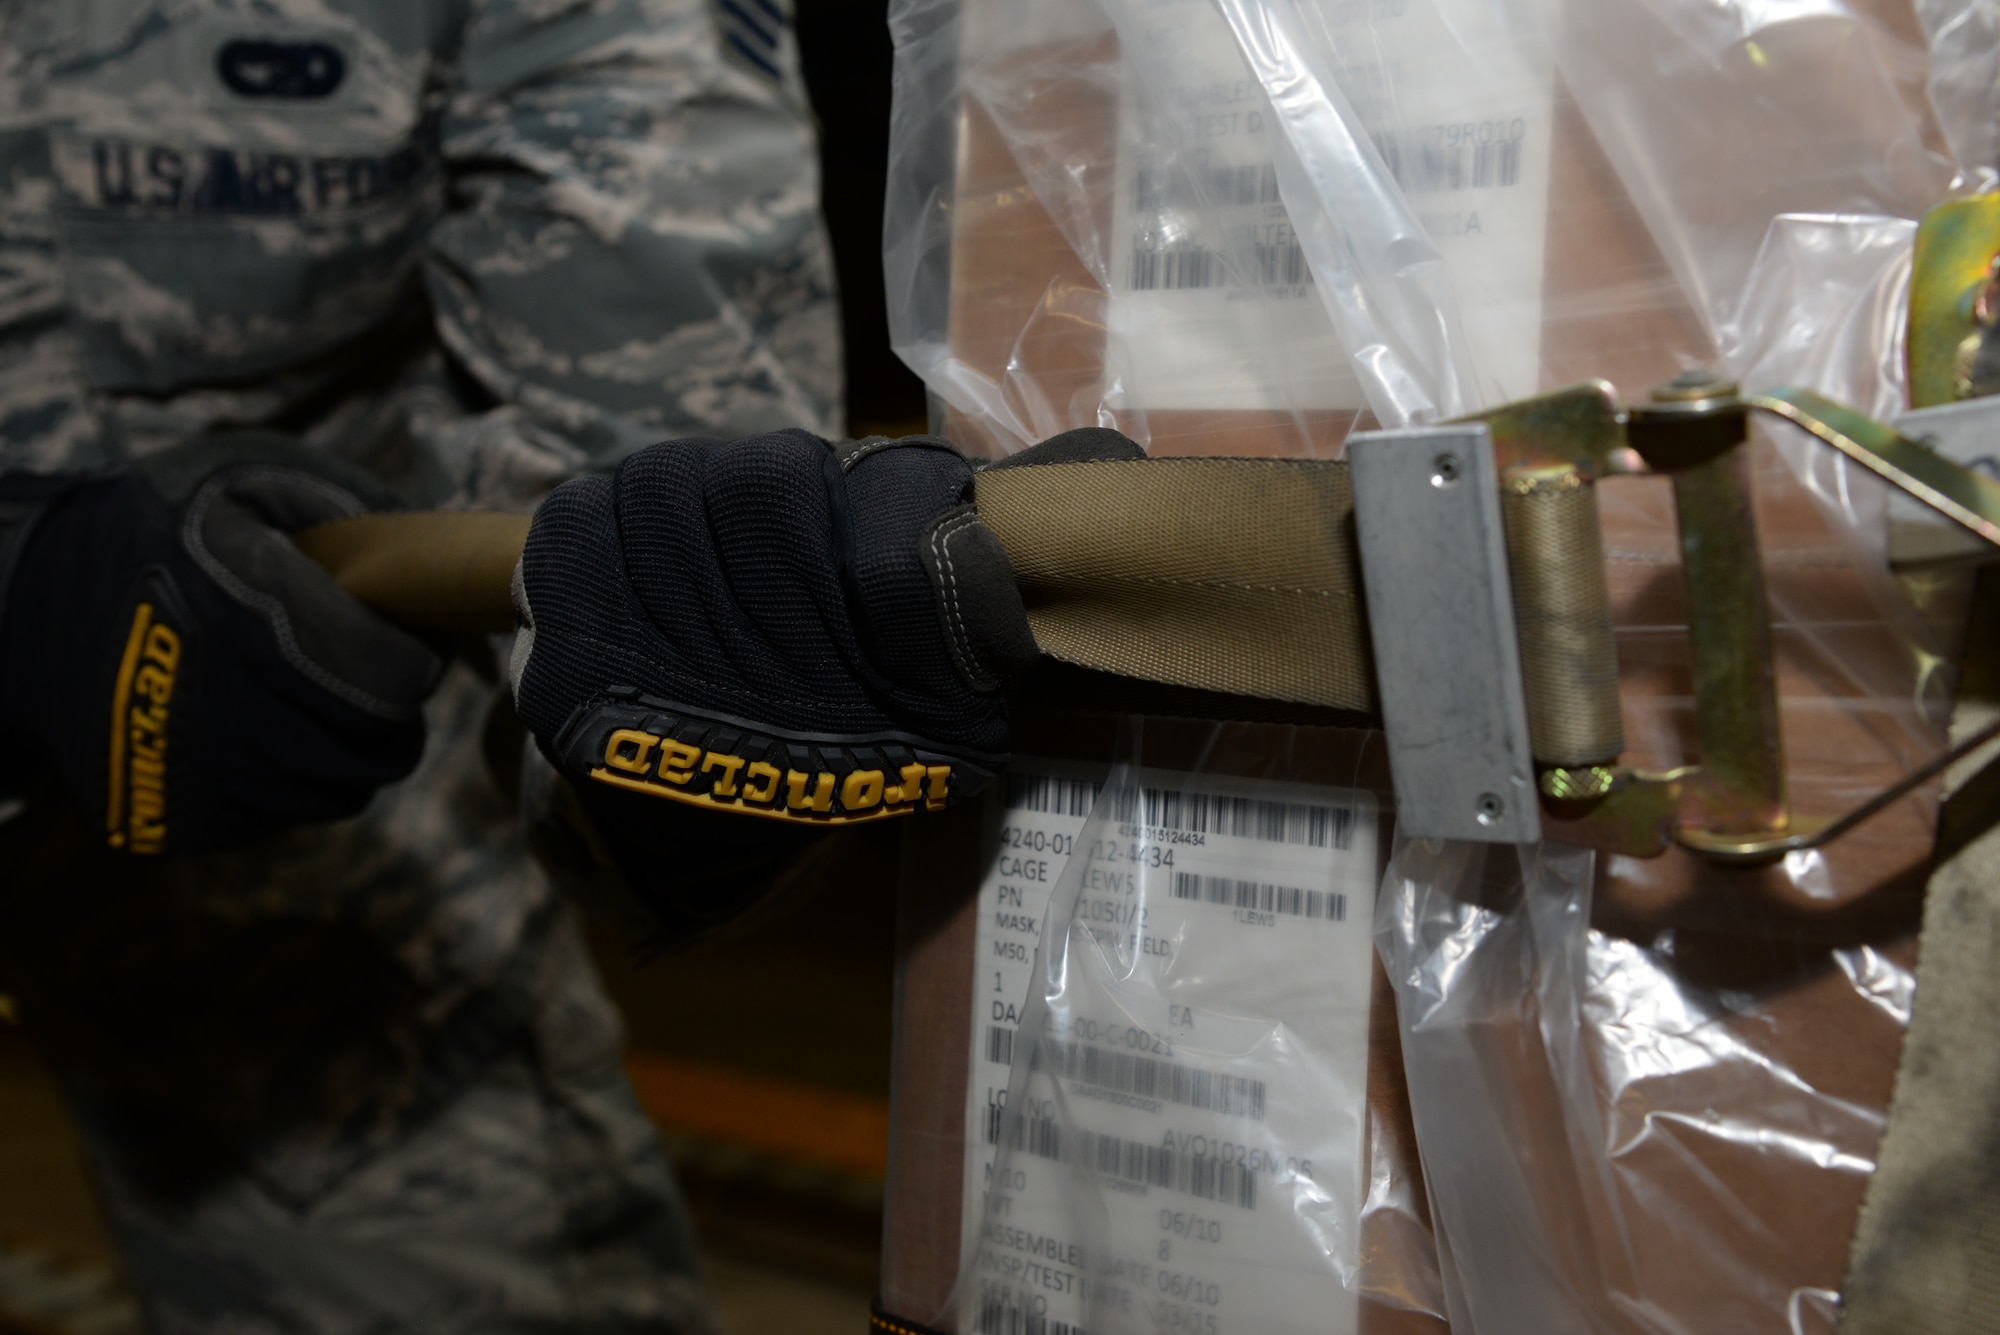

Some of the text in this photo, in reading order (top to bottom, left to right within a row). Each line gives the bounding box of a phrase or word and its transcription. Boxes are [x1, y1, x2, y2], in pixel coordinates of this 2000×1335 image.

[998, 855, 1048, 883] CAGE
[997, 884, 1023, 909] PN
[995, 911, 1040, 937] MASK,
[993, 939, 1029, 965] M50,
[1168, 1003, 1194, 1029] EA
[1159, 1208, 1222, 1244] 06/10
[1157, 1238, 1171, 1262] 8
[1157, 1269, 1220, 1307] 06/10
